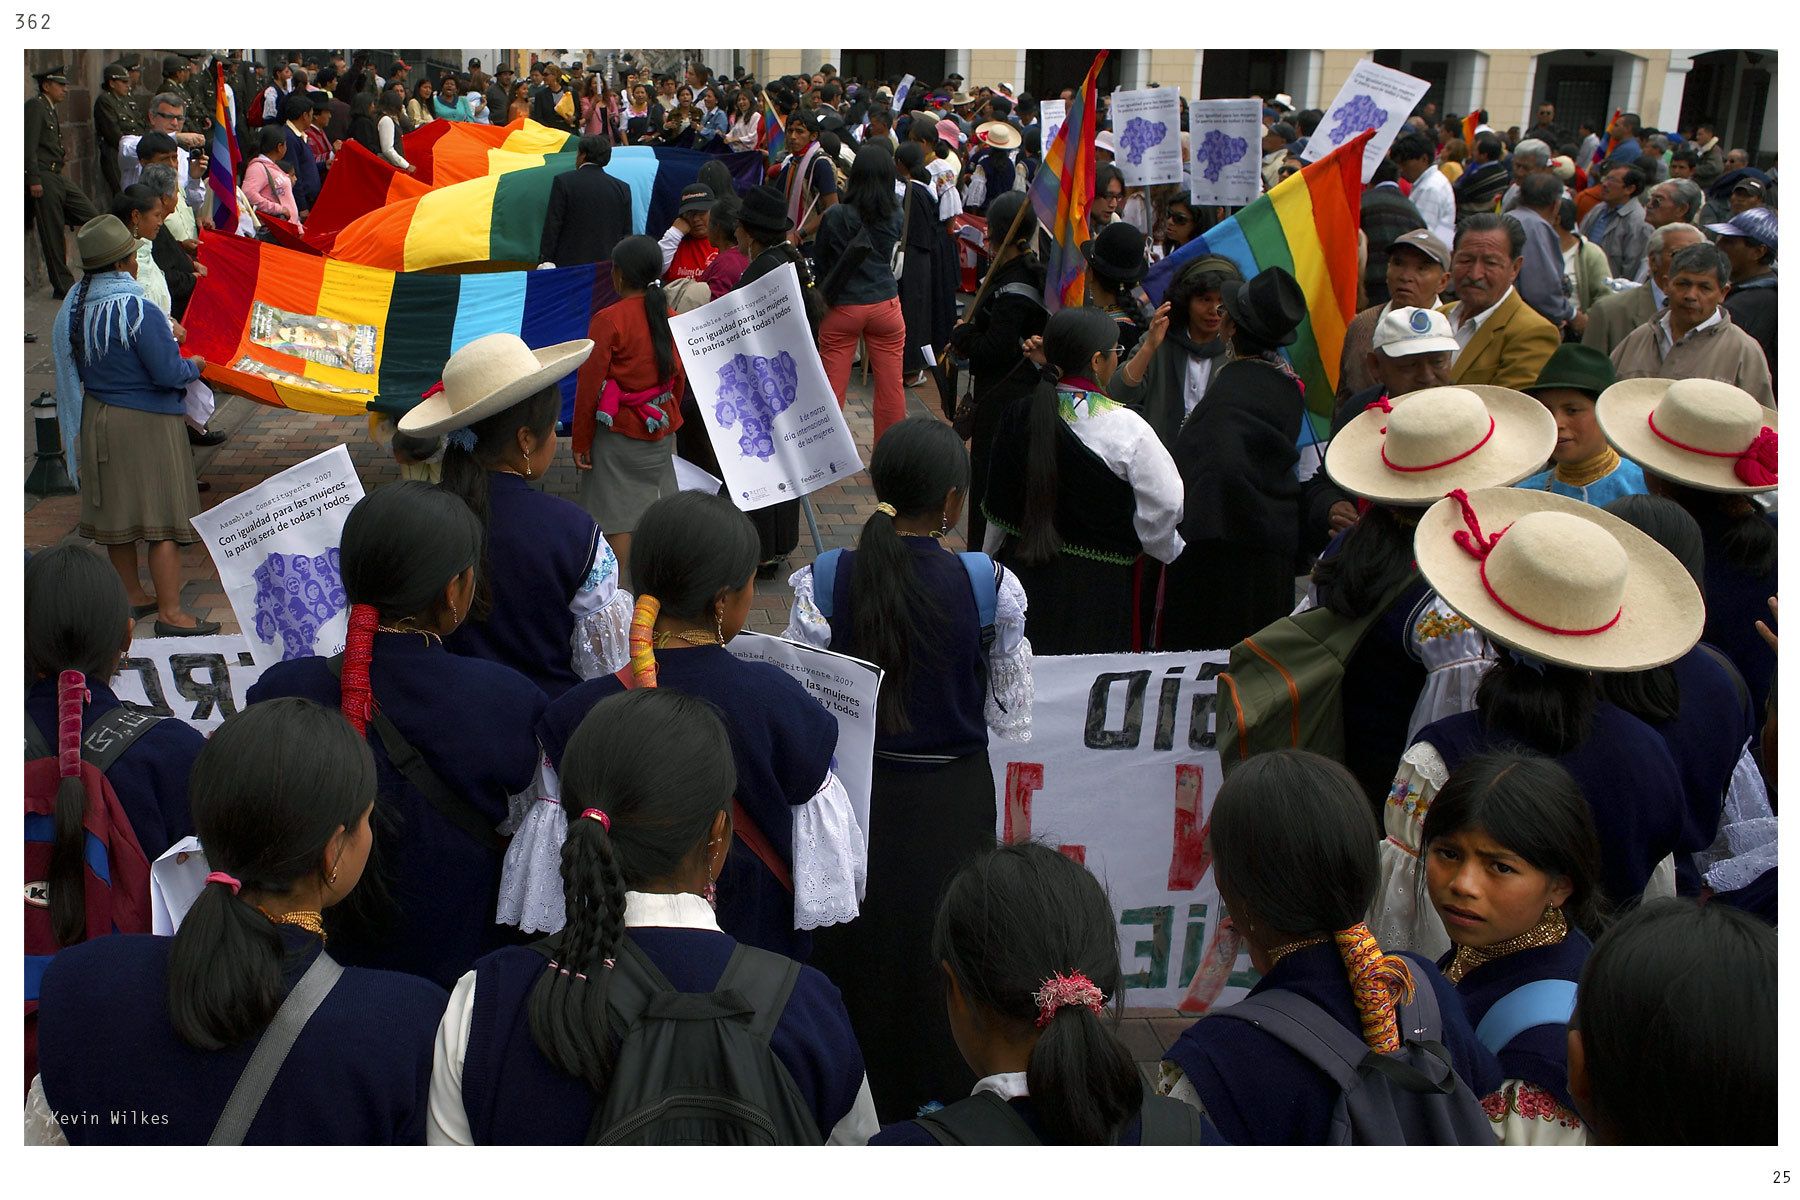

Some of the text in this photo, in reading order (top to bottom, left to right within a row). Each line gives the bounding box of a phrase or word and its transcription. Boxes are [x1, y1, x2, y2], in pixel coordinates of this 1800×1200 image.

[687, 293, 789, 347] Con igualdad para las mujeres
[691, 284, 781, 333] Asamblea Constituyente 2007
[691, 348, 701, 357] la
[701, 340, 725, 355] patria
[726, 330, 741, 344] será
[741, 326, 751, 337] de
[752, 318, 772, 331] todas
[774, 304, 792, 320] todos
[784, 413, 830, 442] día internacional
[804, 412, 810, 421] de
[810, 405, 826, 417] marzo
[797, 426, 835, 449] de las mujeres
[218, 480, 347, 547] Con igualdad para las mujeres
[219, 470, 333, 530] Asamblea Constituyente 2007
[224, 492, 351, 559] la patria será de todas y todos
[767, 656, 831, 679] Constituyente
[835, 675, 854, 687] 2007
[806, 678, 821, 691] las
[823, 686, 860, 707] mujeres
[825, 700, 860, 719] y todos
